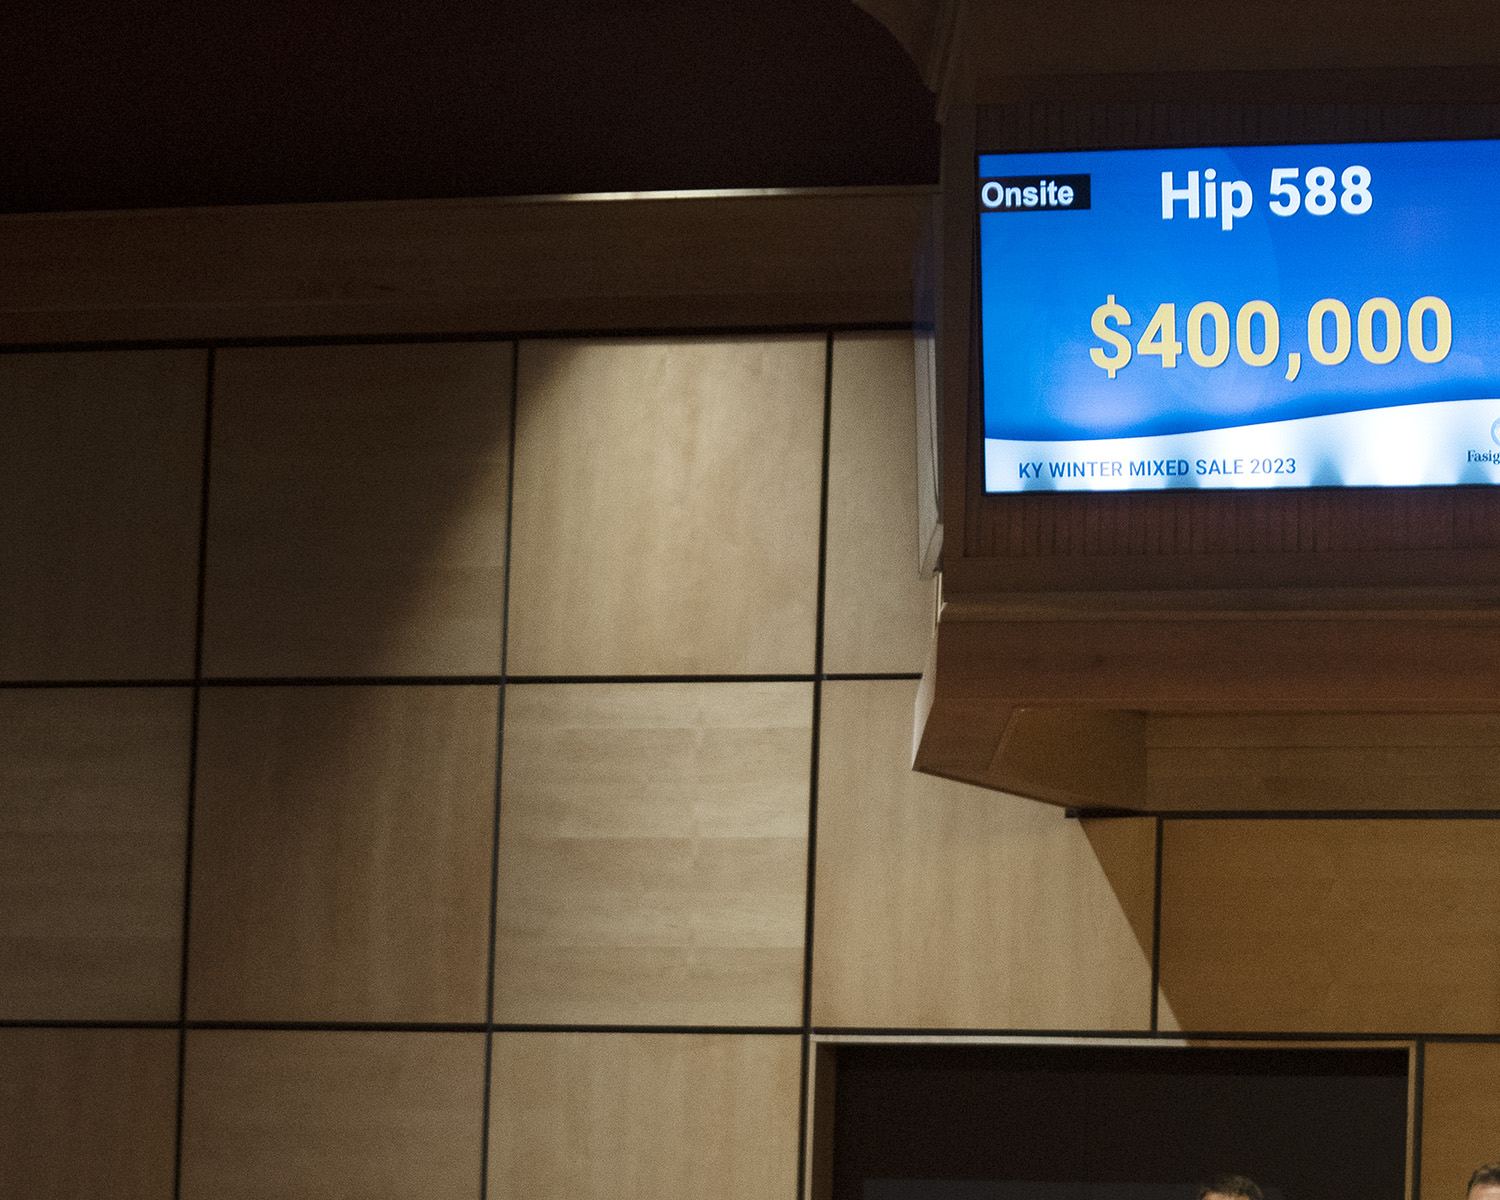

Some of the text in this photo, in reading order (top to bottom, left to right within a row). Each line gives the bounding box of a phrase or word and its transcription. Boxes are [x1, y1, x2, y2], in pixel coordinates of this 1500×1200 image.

[981, 180, 1075, 208] Onsite
[1160, 165, 1373, 231] Hip 588
[1088, 293, 1454, 382] $400,000
[1018, 457, 1297, 479] KY WINTER MIXED SALE 2023
